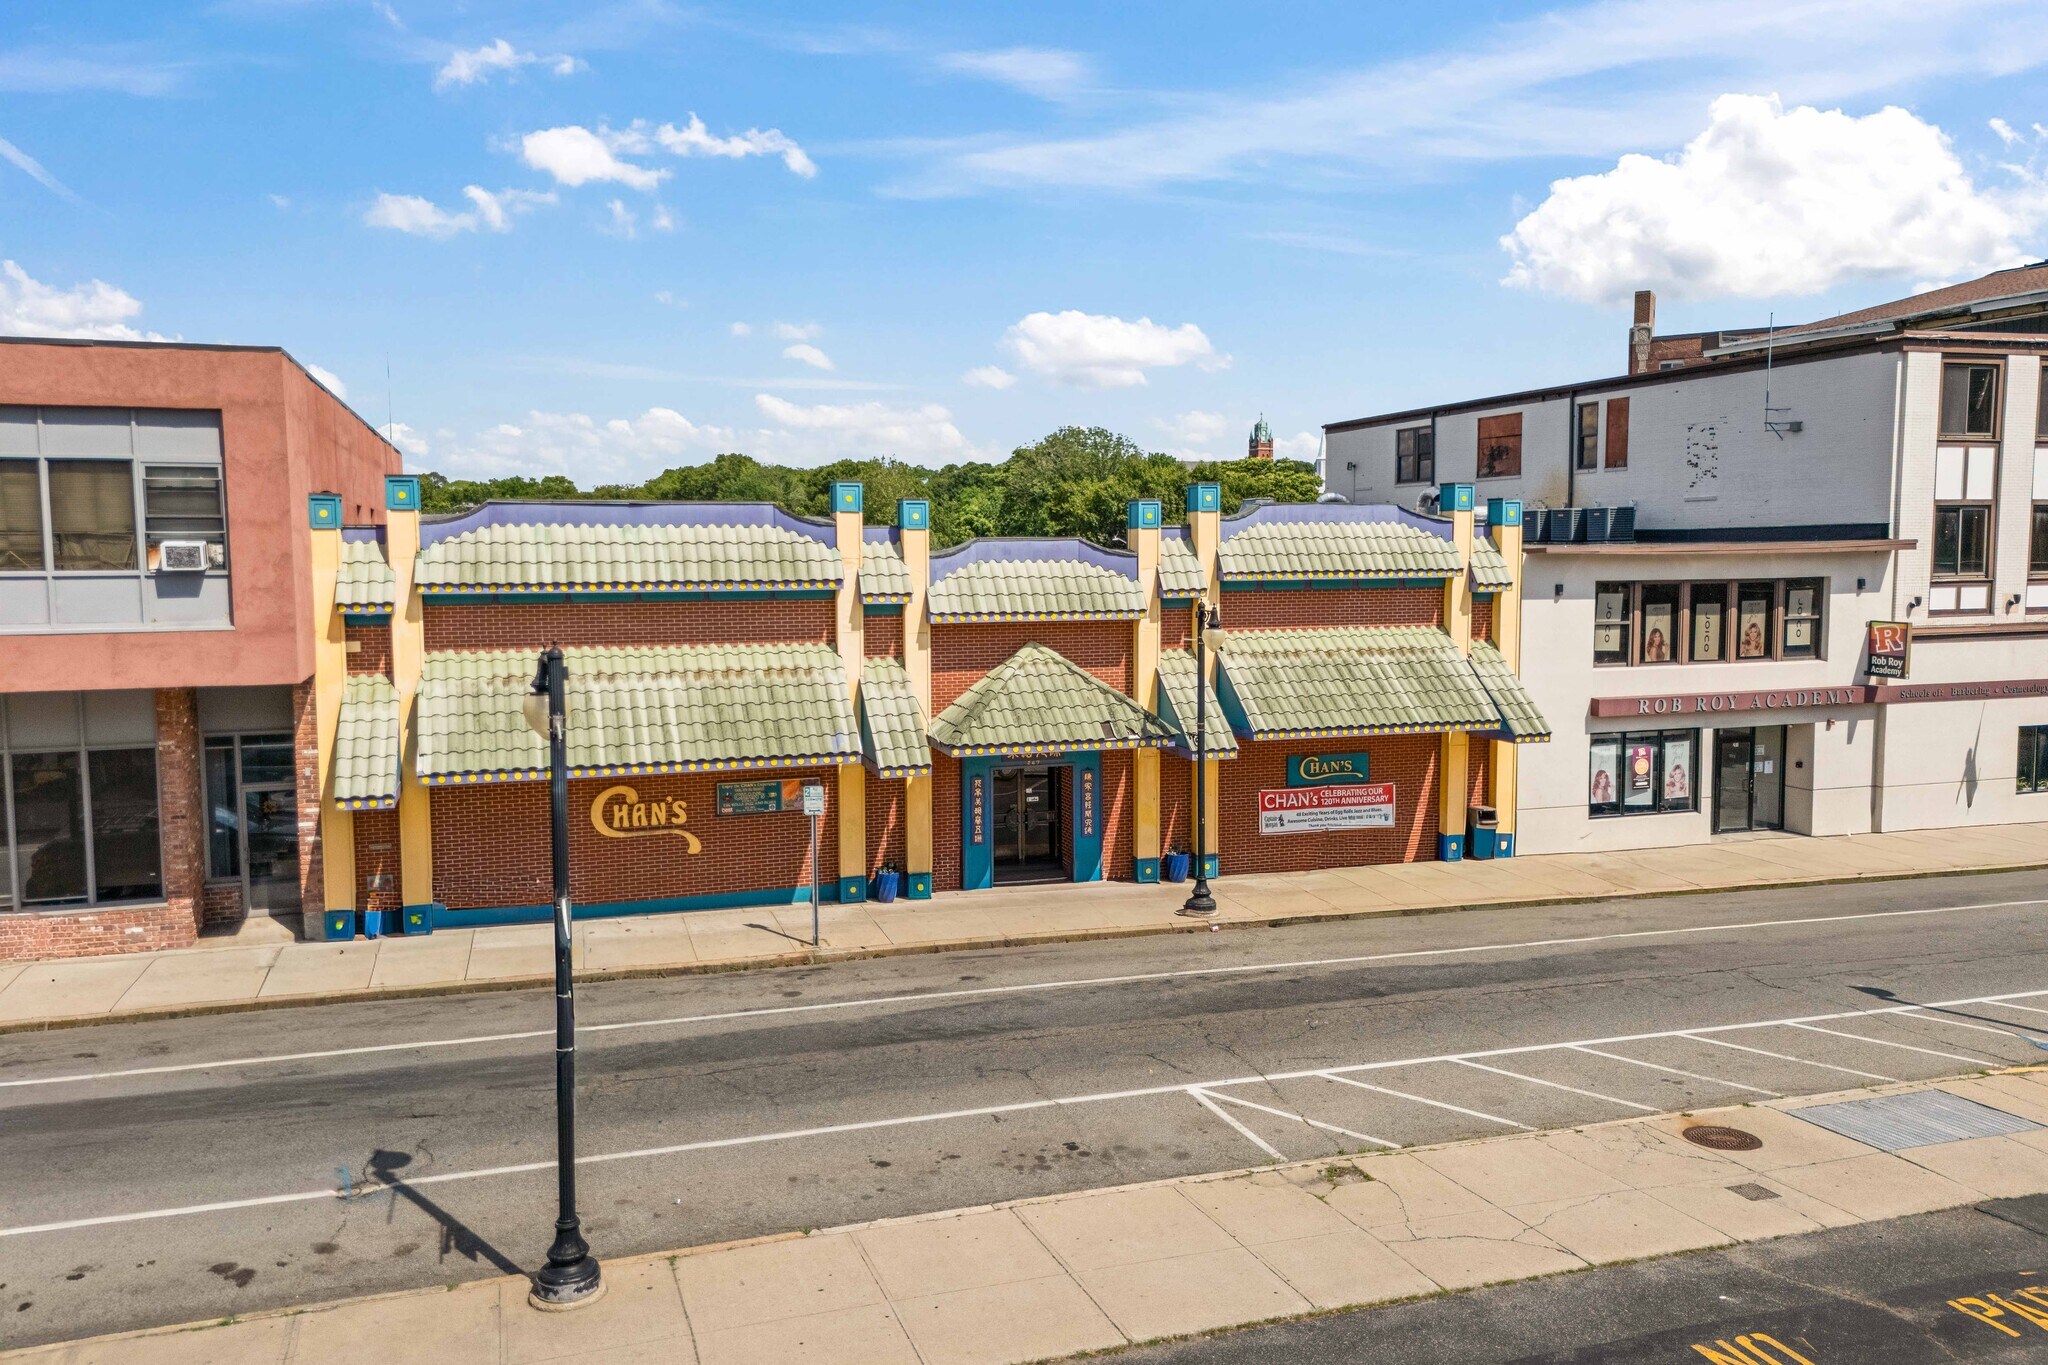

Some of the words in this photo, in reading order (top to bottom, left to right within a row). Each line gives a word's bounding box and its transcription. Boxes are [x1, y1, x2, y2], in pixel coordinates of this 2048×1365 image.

[1604, 602, 1612, 643] JOCO
[1874, 625, 1904, 653] R
[1871, 656, 1887, 665] Rob
[1888, 657, 1904, 669] Roy
[1870, 665, 1902, 677] Academy
[1900, 687, 1930, 699] Schools
[1951, 686, 1990, 697] Barbering
[1637, 697, 1682, 716] ROB
[1695, 695, 1743, 712] ROY
[1749, 689, 1856, 709] ACADEMY
[1300, 756, 1364, 780] CHAN'S
[805, 788, 810, 796] 2
[1320, 788, 1367, 797] CELEBRATING
[1368, 787, 1383, 795] OUR
[1341, 794, 1389, 804] ANNIVERSARY
[1264, 792, 1318, 809] CHAN's
[590, 785, 701, 854] CHAN'S
